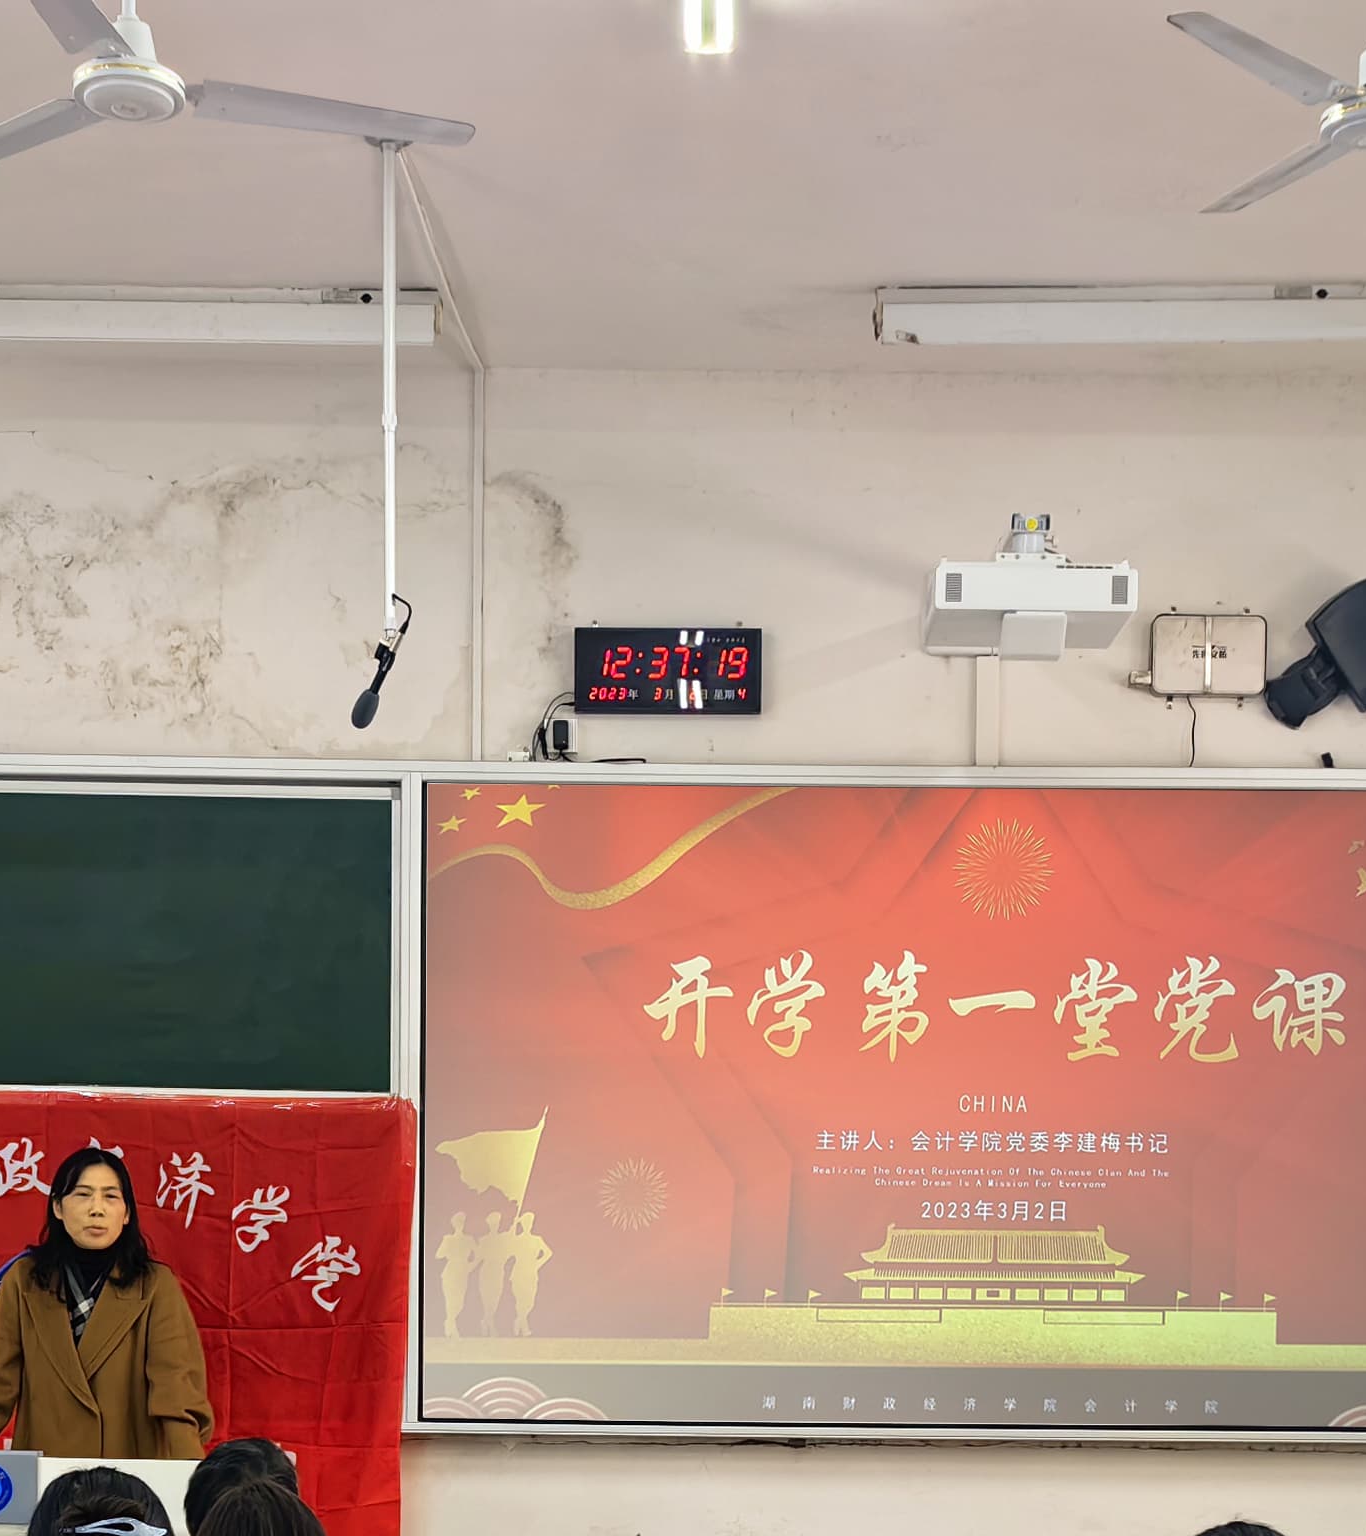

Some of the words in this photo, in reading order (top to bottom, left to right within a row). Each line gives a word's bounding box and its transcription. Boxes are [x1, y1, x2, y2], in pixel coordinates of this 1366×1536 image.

[602, 646, 748, 679] 12:37:19
[642, 950, 1347, 1062] 开学第一堂党课
[958, 1094, 1028, 1113] CHINA
[812, 1165, 866, 1176] Realizing
[873, 1166, 890, 1176] The
[931, 1166, 1003, 1177] Rejuvenation
[1027, 1168, 1044, 1177] The
[1050, 1168, 1092, 1177] Chinese
[1128, 1168, 1146, 1178] And
[1152, 1168, 1170, 1178] The
[874, 1178, 916, 1187] Chinese
[987, 1179, 1029, 1188] Mission
[1058, 1180, 1107, 1189] Everyone
[921, 1199, 1067, 1222] 2023年3月2日
